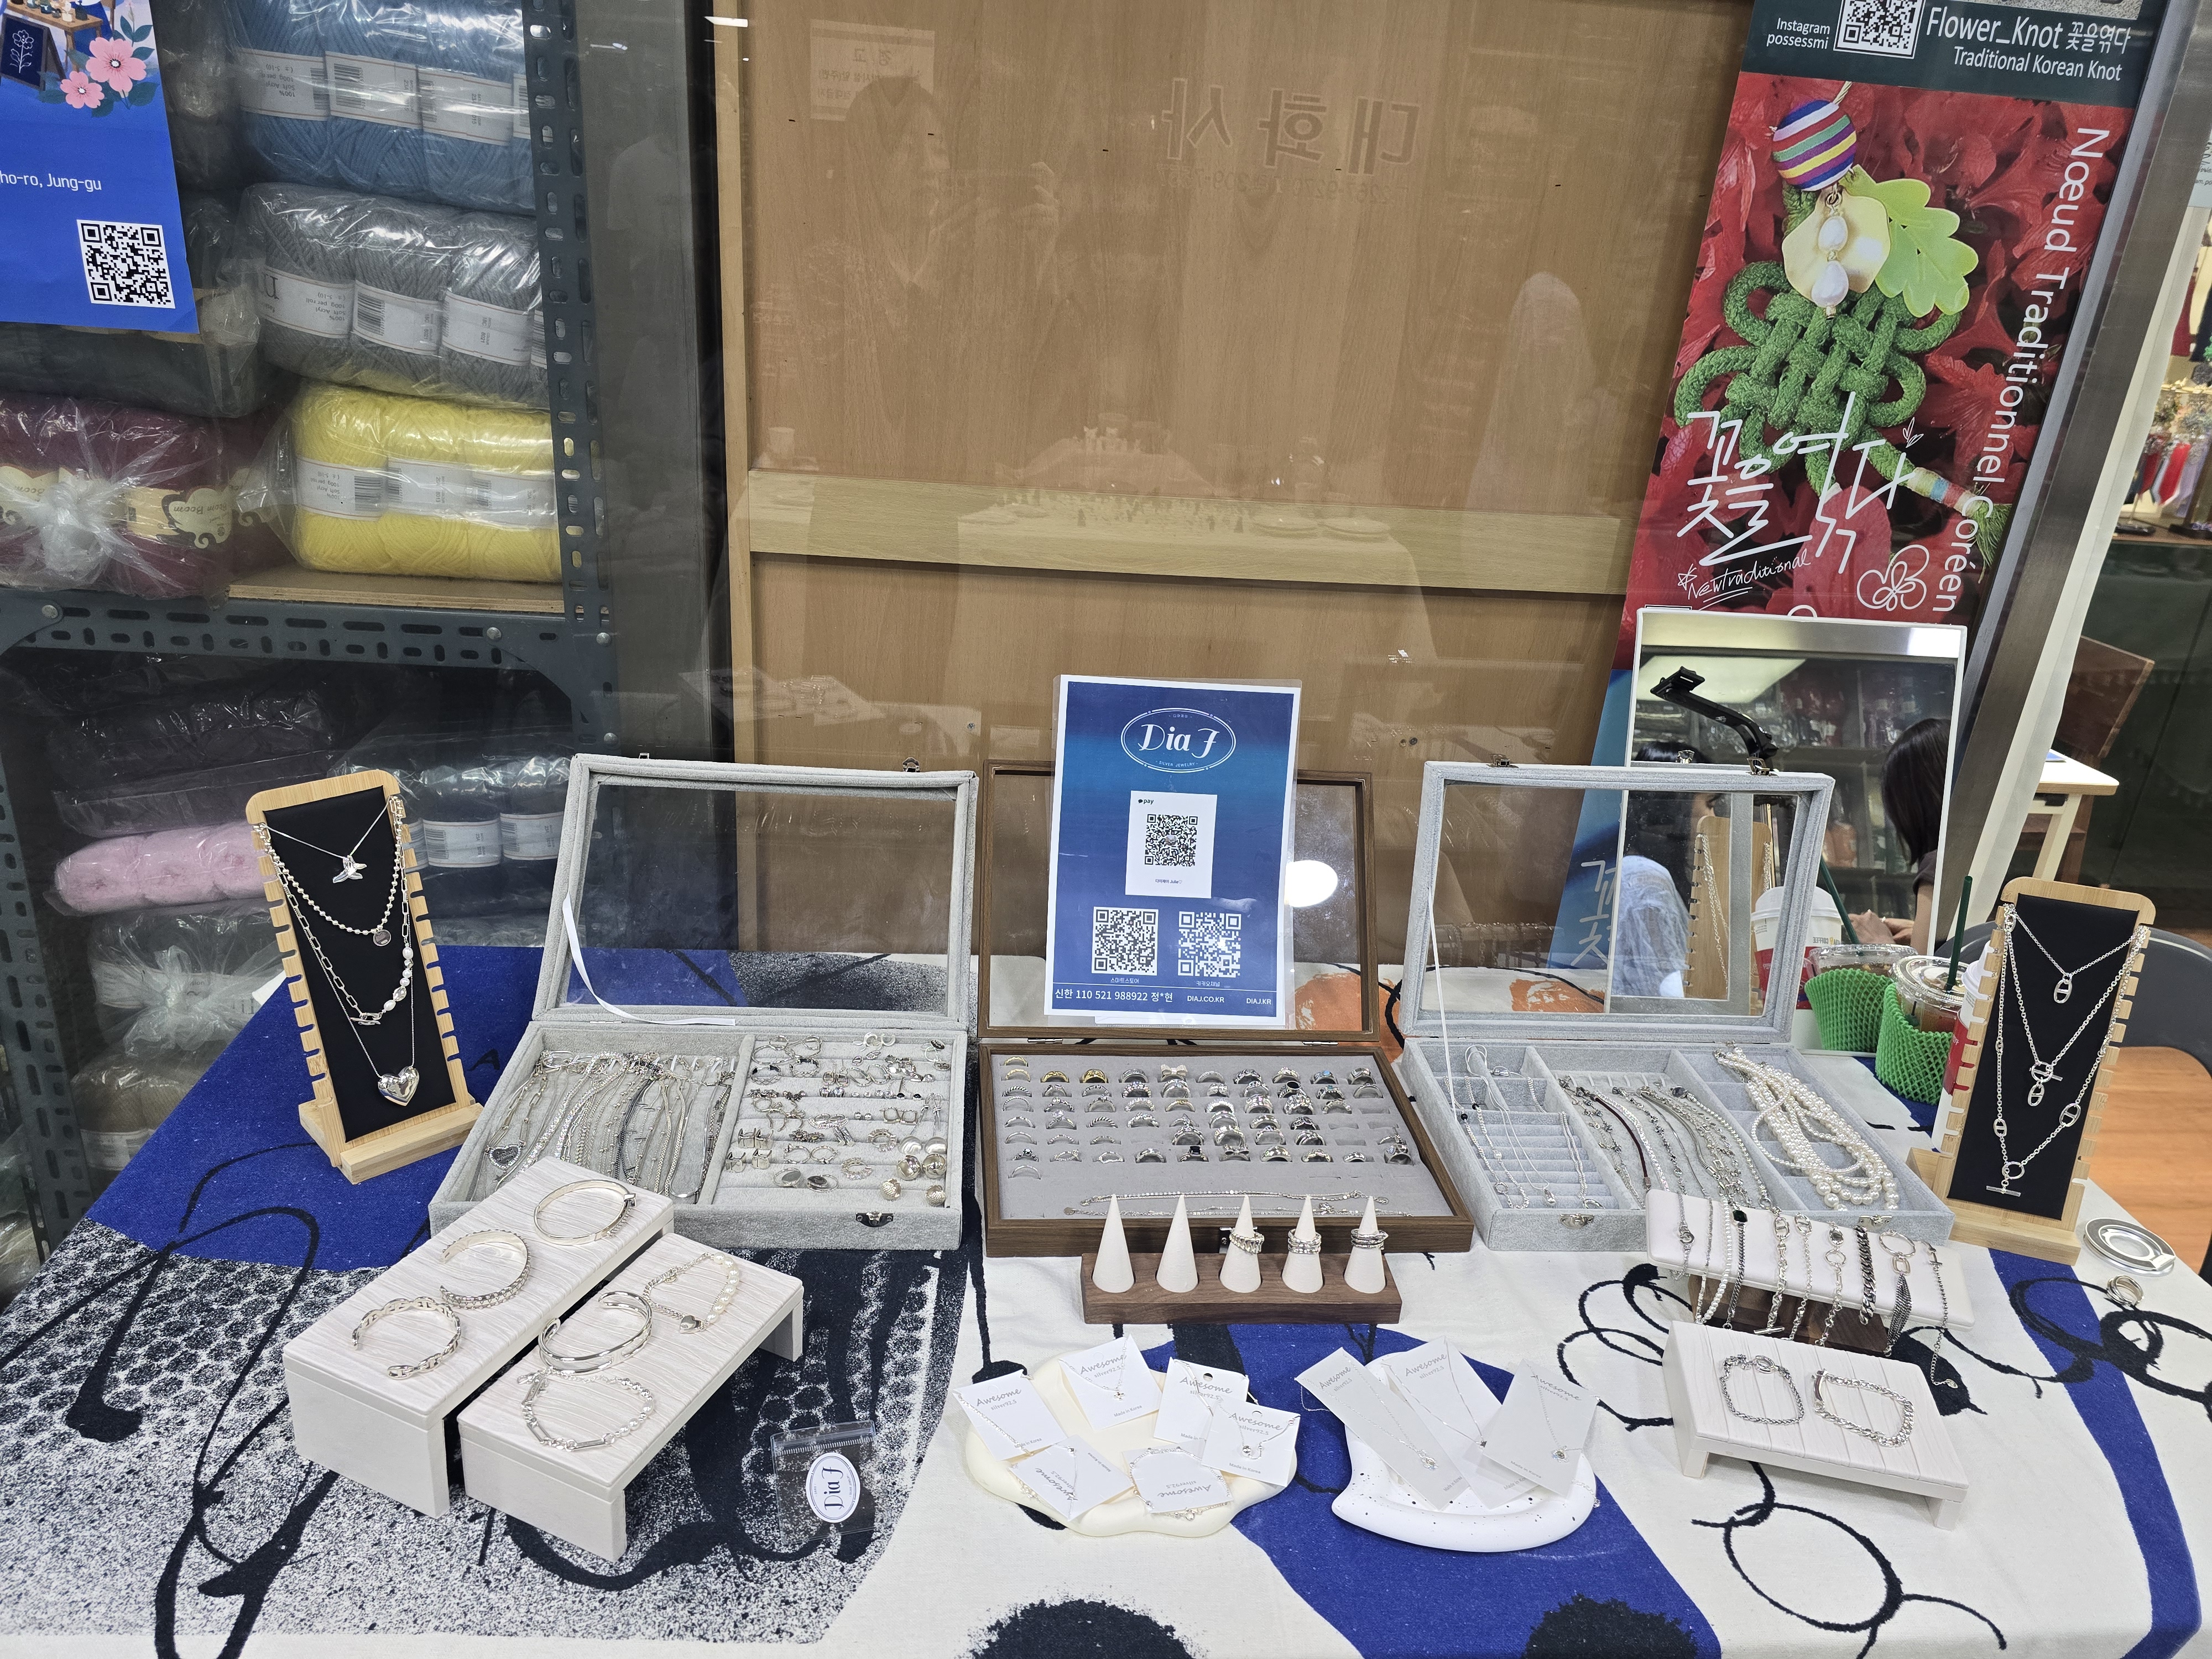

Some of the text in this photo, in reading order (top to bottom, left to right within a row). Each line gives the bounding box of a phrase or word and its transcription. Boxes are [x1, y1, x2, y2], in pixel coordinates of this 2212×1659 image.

[1776, 17, 1830, 36] Instagram
[1926, 7, 2131, 55] Flower_Knot 꽃을엮다
[1766, 33, 1829, 50] possessmi
[1954, 46, 2122, 82] Traditional Korean Knot
[0, 170, 102, 192] ho-ro, Jung-gu
[1932, 127, 2110, 612] Nœud Traditionnel Coréen
[174, 506, 204, 515] Boom
[1138, 724, 1191, 751] Dia
[1055, 989, 1073, 999] 신한
[1076, 990, 1092, 999] 110
[1095, 990, 1112, 1000] 521
[1114, 991, 1148, 1001] 988922
[1081, 1355, 1126, 1374] Awesome
[1094, 1365, 1121, 1378] silver92.5
[1405, 1353, 1447, 1376] Awesome
[1419, 1366, 1444, 1379] silver92.5
[1180, 1376, 1233, 1394] Awesome
[1319, 1366, 1351, 1389] Awesome
[977, 1389, 1021, 1406] Awesome
[991, 1400, 1017, 1410] silver92.5
[1229, 1413, 1283, 1431] Awesome
[1239, 1425, 1269, 1436] silver92.5
[1088, 1452, 1098, 1462] Korea
[1511, 1460, 1522, 1469] Made
[1157, 1485, 1211, 1497] Awesome
[1166, 1480, 1196, 1489] silver92.5
[823, 1480, 844, 1511] Dia
